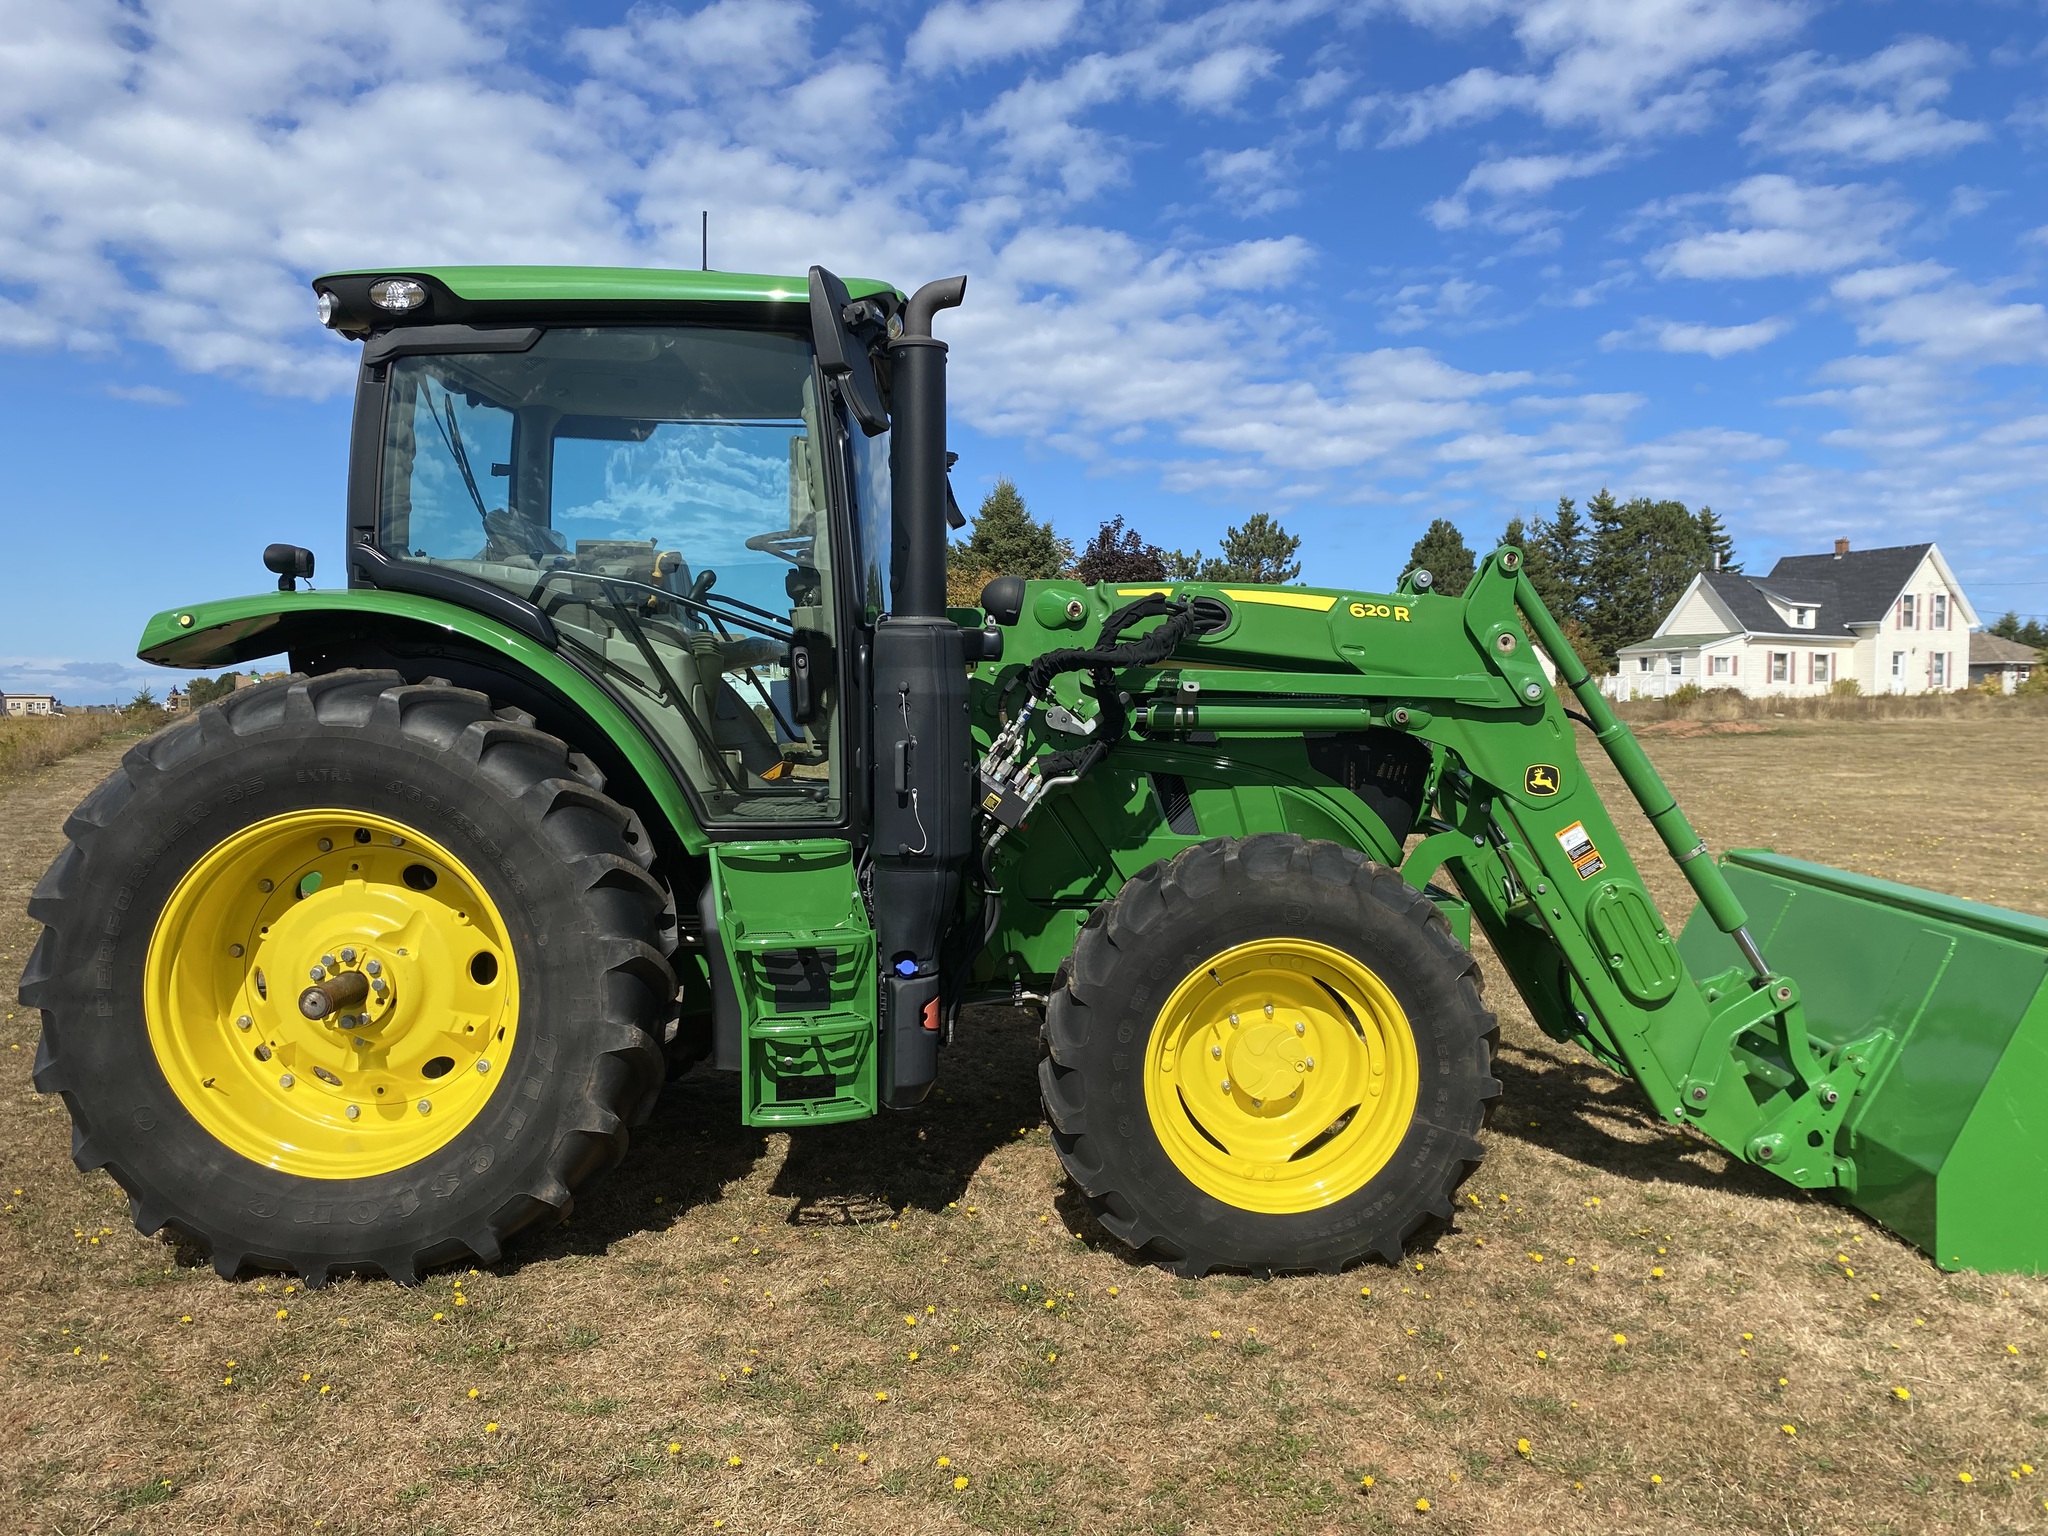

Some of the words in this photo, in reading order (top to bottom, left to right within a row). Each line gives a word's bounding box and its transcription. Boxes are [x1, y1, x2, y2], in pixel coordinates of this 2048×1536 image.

[1349, 602, 1390, 618] 620
[1393, 606, 1412, 622] R
[96, 797, 211, 1018] PERFORMER
[221, 775, 267, 806] 85
[296, 768, 352, 783] EXTRA
[1410, 1128, 1437, 1170] EXTRA
